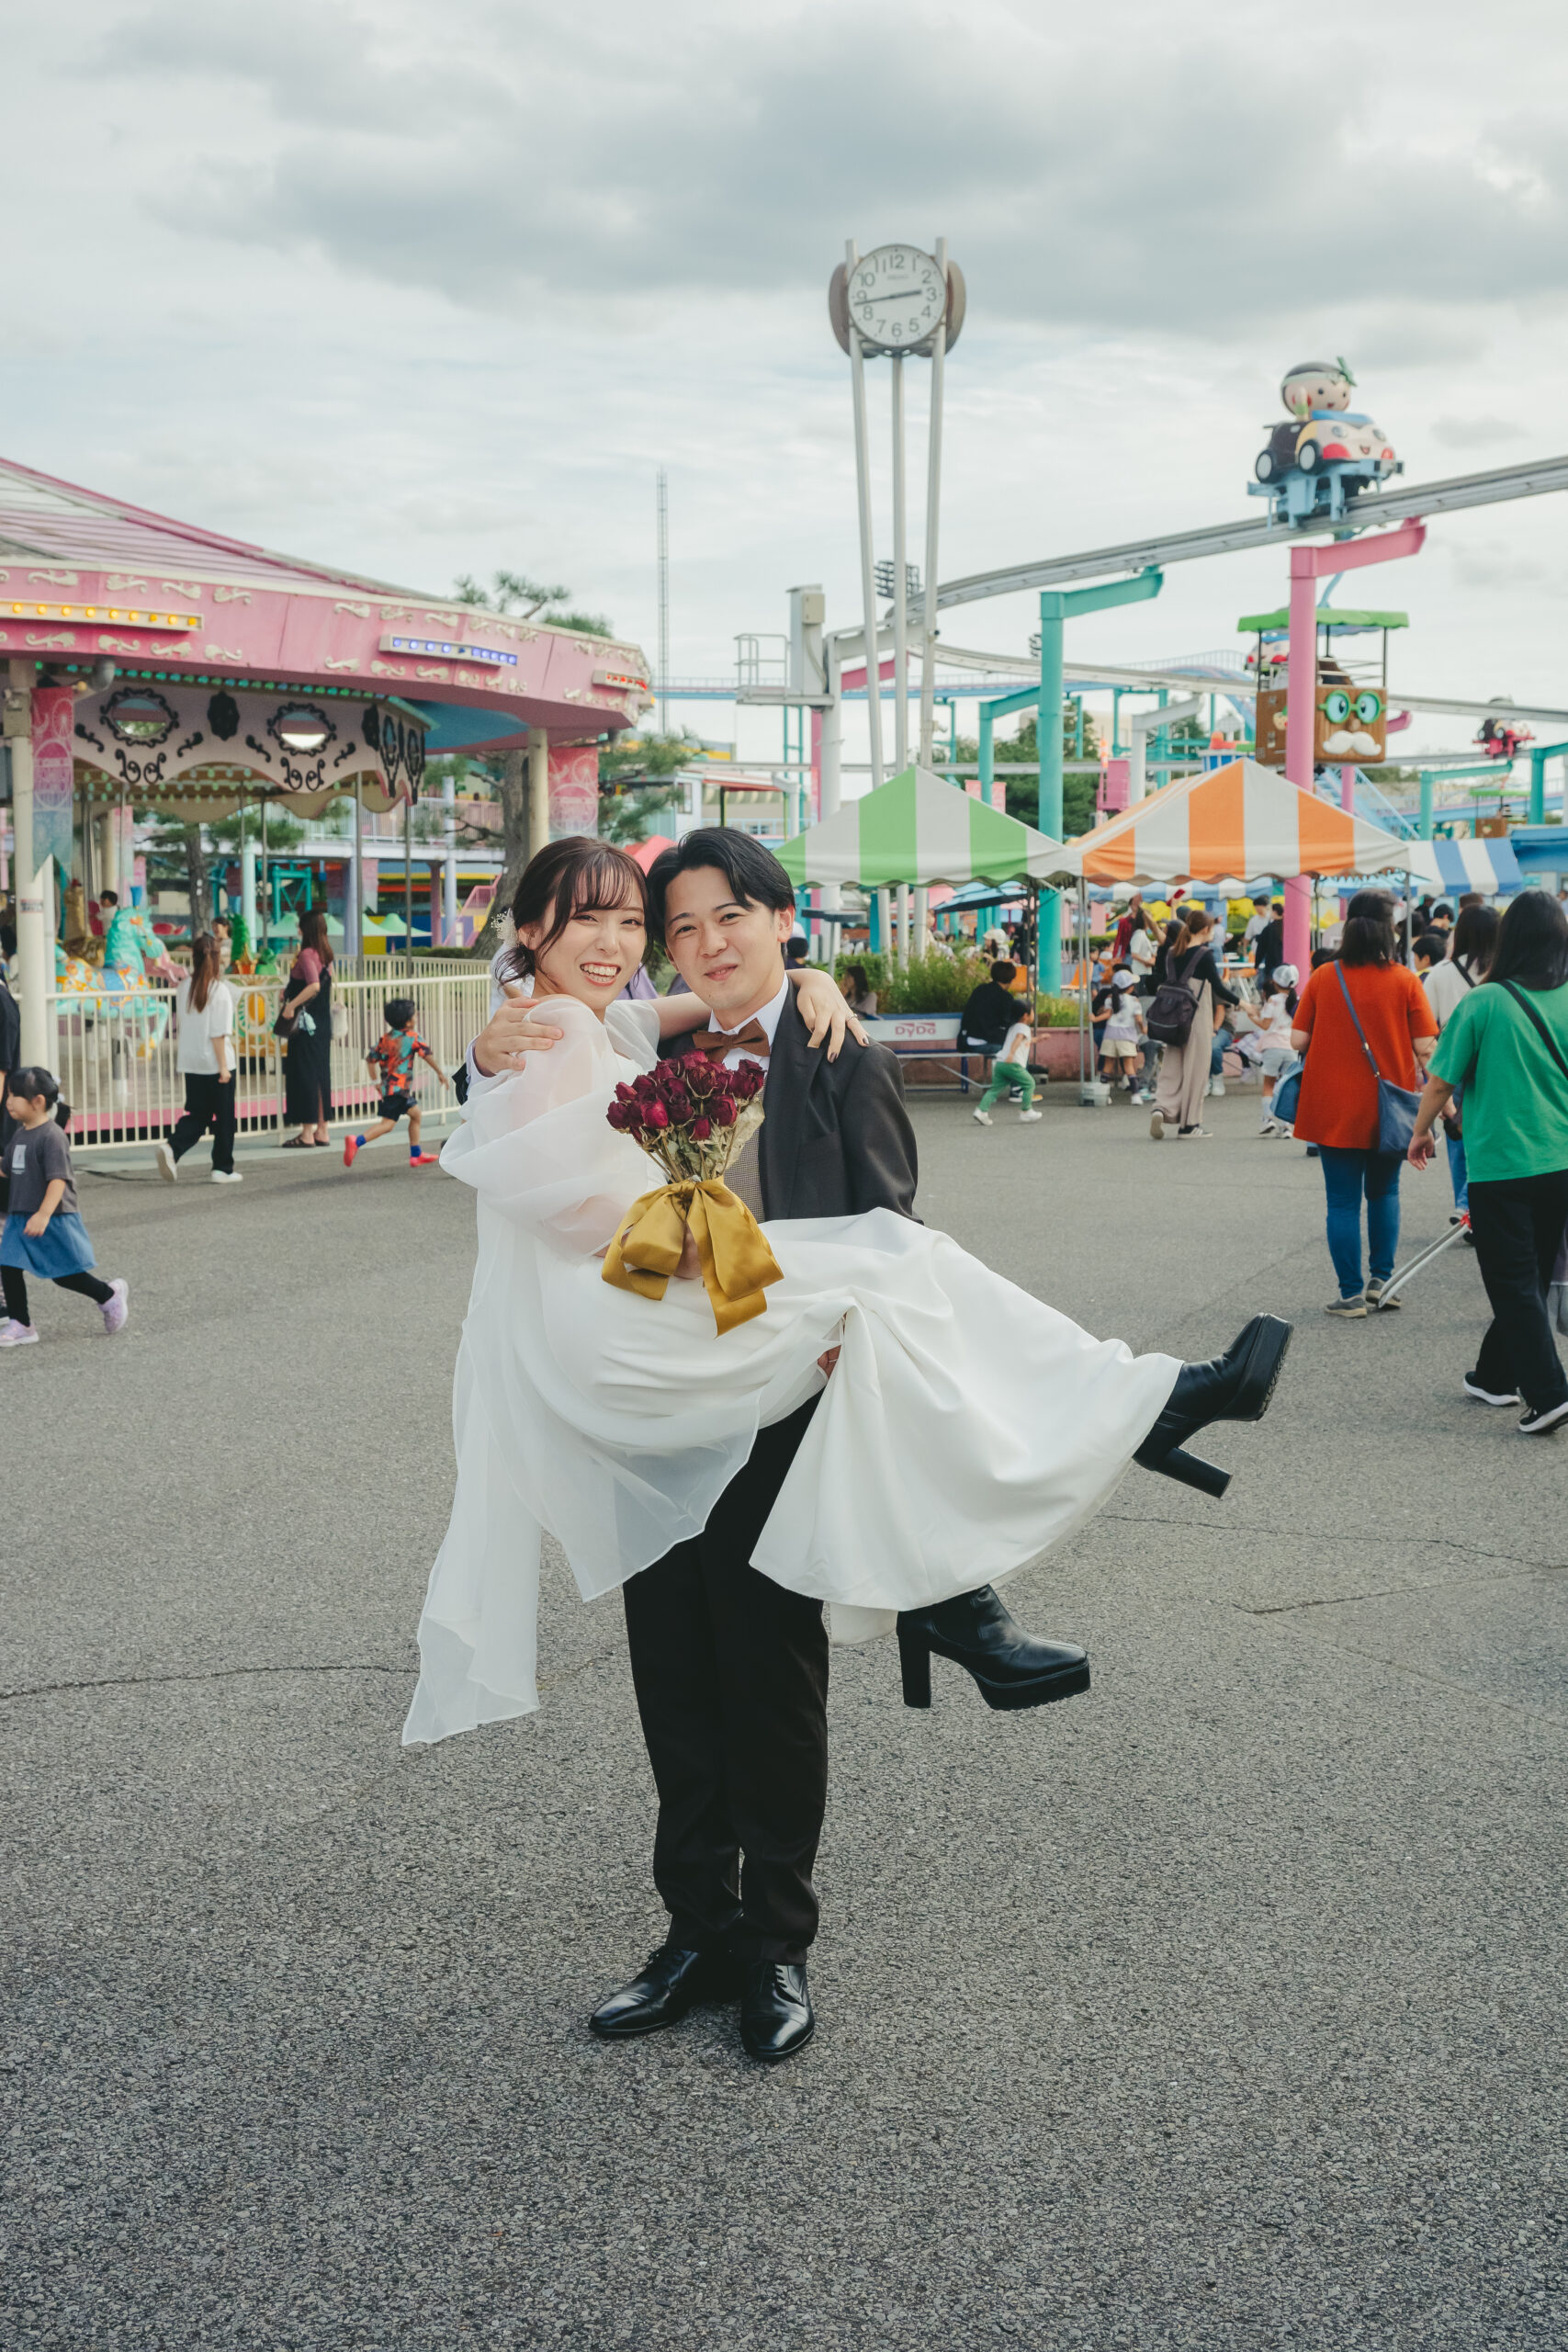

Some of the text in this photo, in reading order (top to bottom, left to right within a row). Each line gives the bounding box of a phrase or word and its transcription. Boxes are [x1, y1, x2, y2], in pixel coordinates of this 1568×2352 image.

[874, 256, 886, 273] 11
[889, 254, 904, 269] 12
[857, 272, 875, 287] 10
[921, 269, 931, 284] 2
[856, 289, 868, 304] 9
[927, 287, 937, 301] 3
[863, 305, 874, 321] 8
[920, 304, 931, 319] 4
[876, 319, 886, 334] 7
[891, 322, 902, 337] 6
[909, 318, 919, 333] 5
[895, 1022, 937, 1037] DyDo
